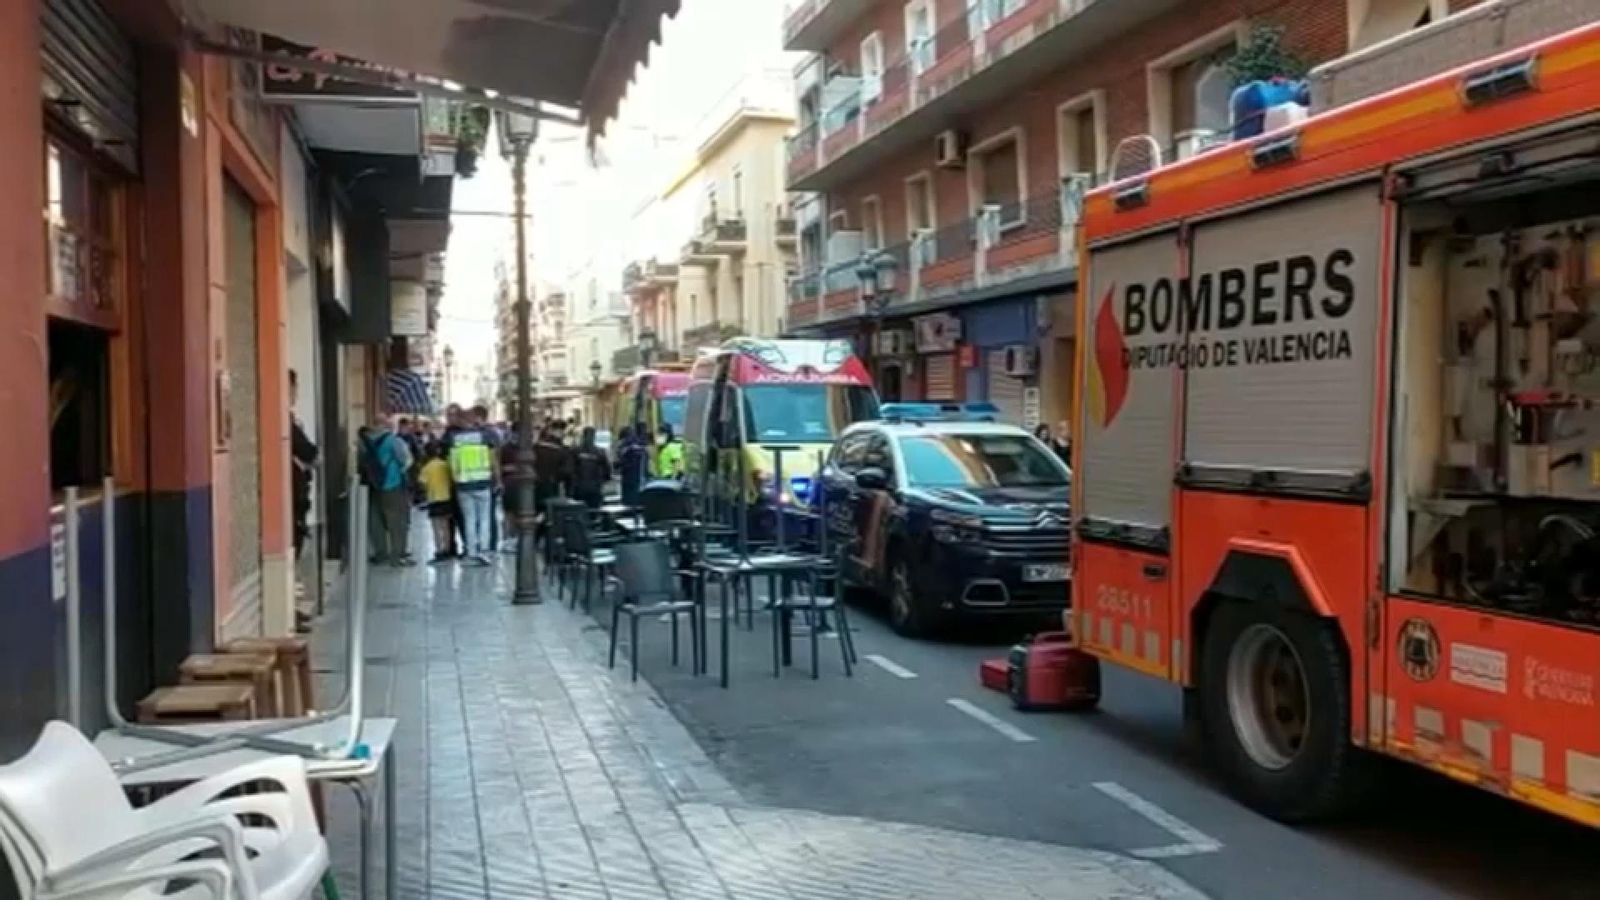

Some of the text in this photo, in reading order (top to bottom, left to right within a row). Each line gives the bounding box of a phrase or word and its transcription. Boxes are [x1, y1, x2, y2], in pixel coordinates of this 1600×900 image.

[1124, 249, 1355, 335] BOMBERS
[1213, 340, 1238, 367] DE
[1243, 330, 1353, 362] VALENCIA
